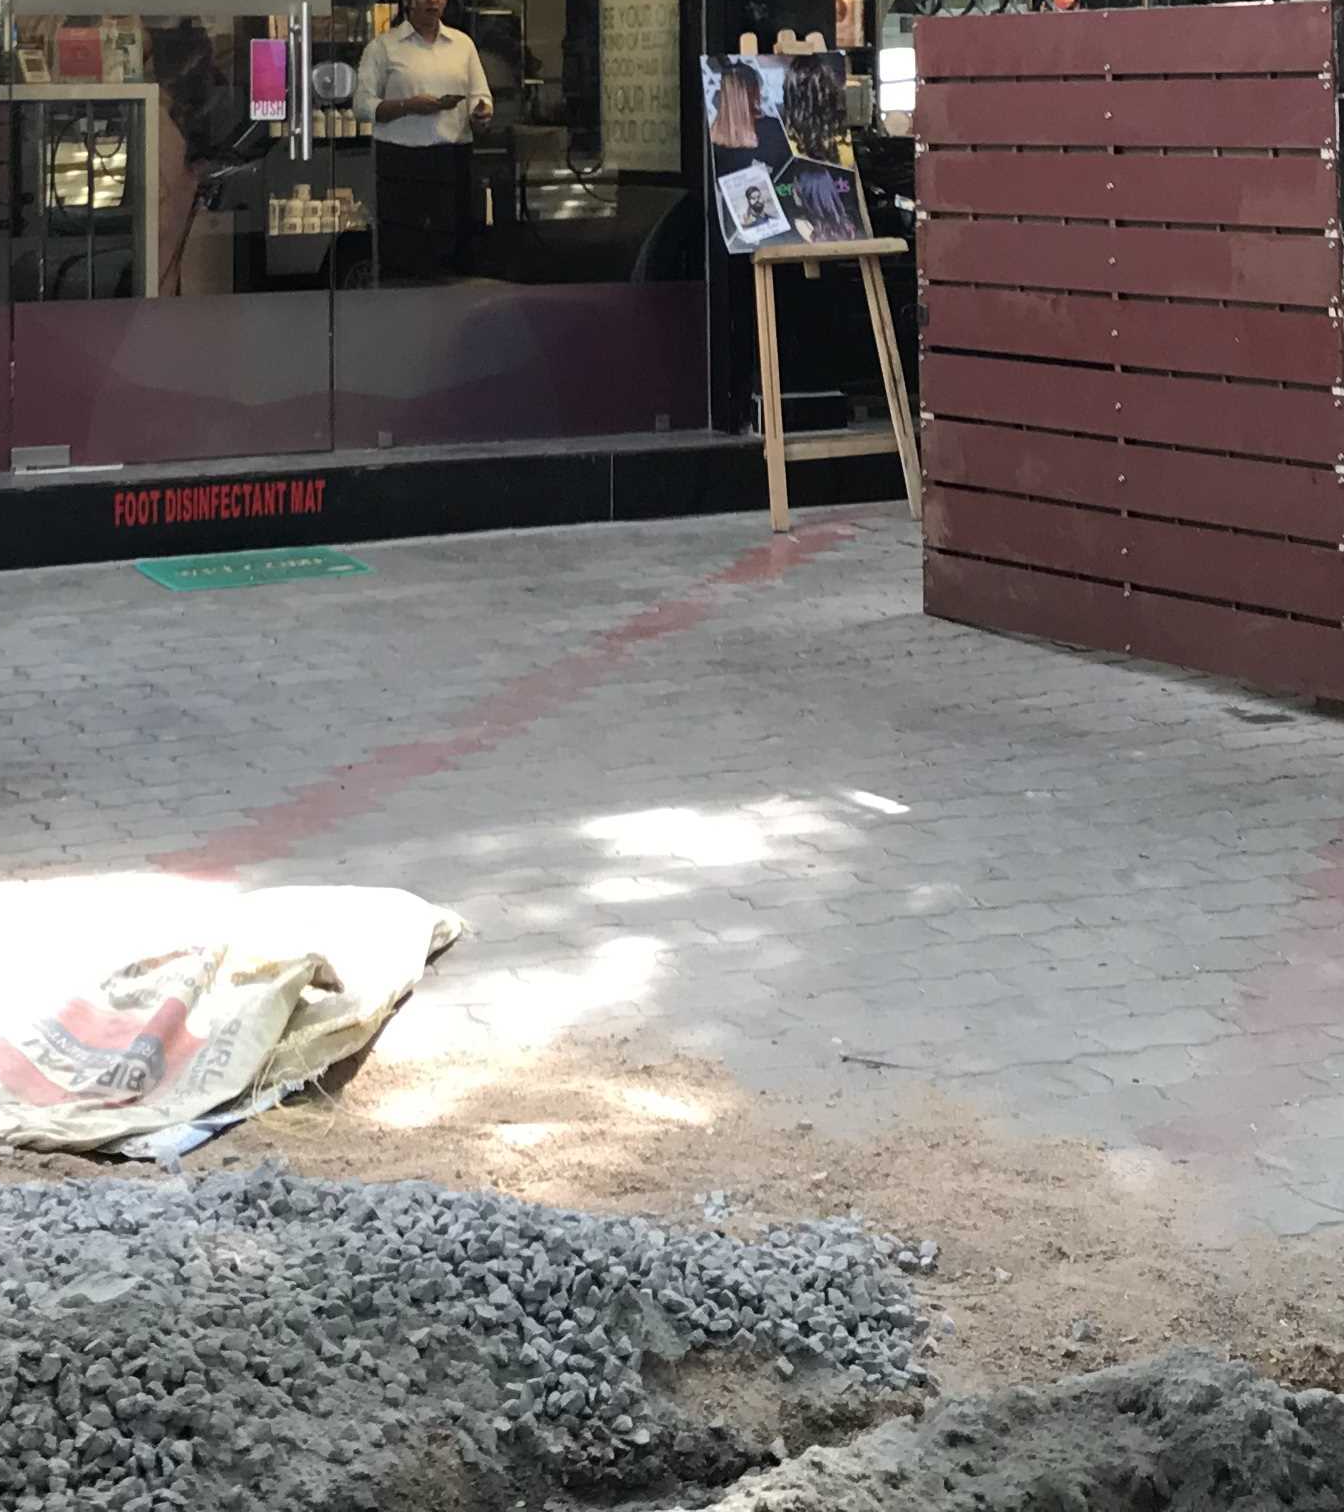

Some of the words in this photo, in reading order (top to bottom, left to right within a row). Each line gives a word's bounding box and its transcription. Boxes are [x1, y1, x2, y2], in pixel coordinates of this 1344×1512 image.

[253, 100, 285, 116] PUSH
[113, 490, 161, 529] FOOT
[163, 481, 287, 524] DISINFECTANT
[290, 478, 327, 514] MAT
